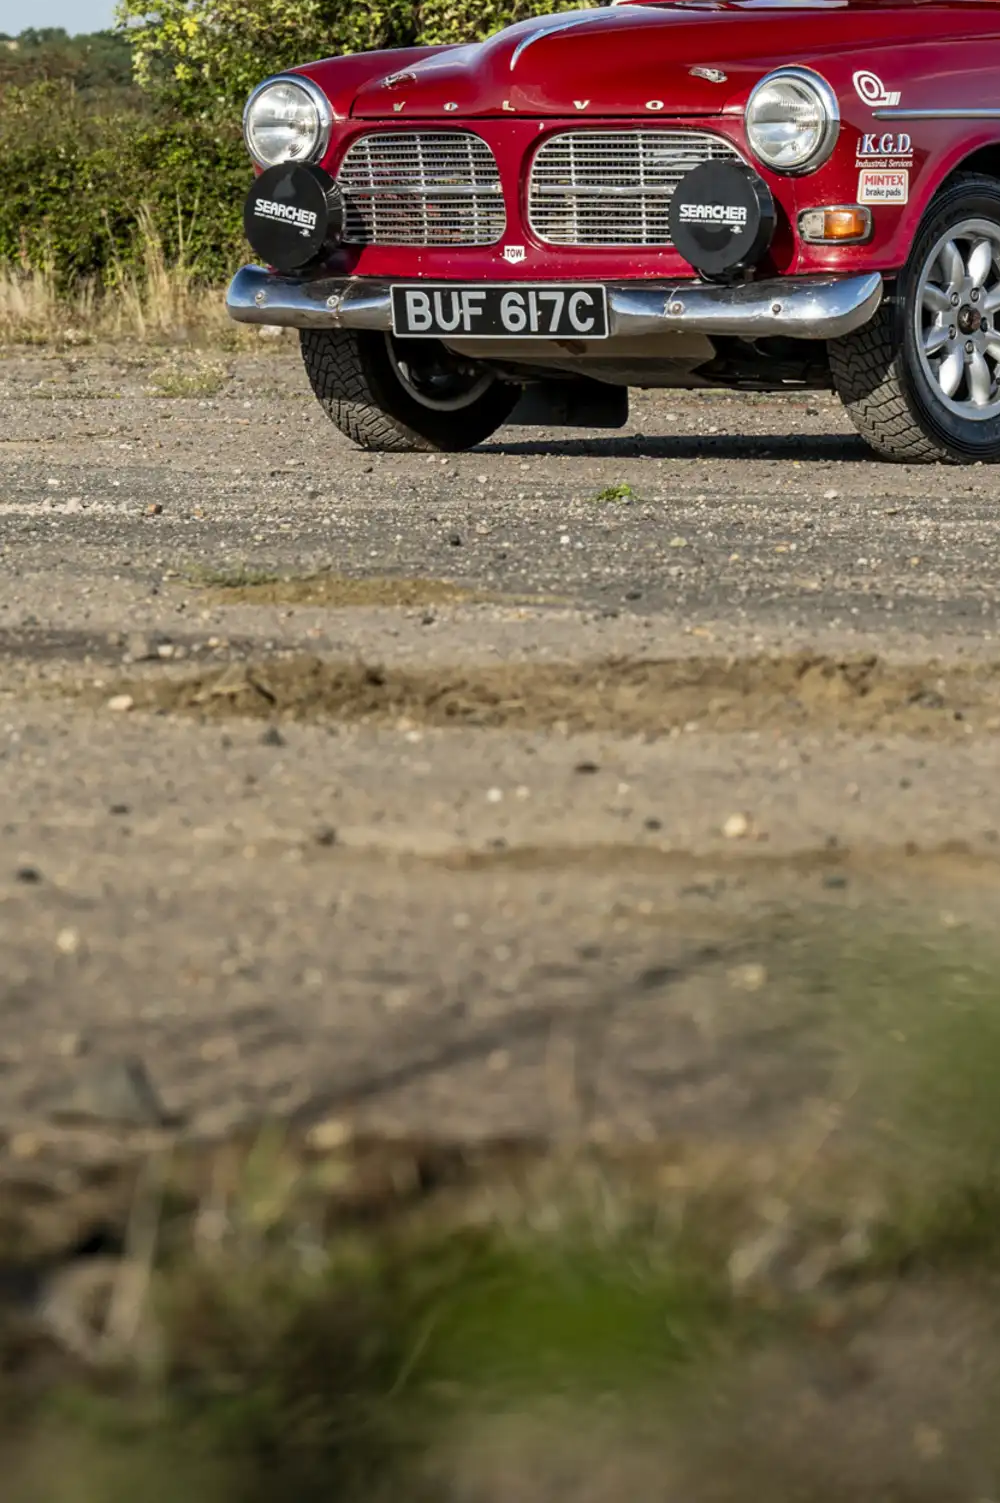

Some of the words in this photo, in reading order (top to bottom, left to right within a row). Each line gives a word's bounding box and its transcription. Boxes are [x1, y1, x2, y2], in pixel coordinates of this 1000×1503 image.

[393, 99, 664, 112] VOLVO
[861, 133, 914, 154] K.G.D.
[855, 159, 887, 168] Industrial
[888, 159, 913, 168] Services
[864, 175, 903, 186] MINTEX
[866, 188, 885, 196] brake
[886, 188, 901, 198] pads
[254, 198, 317, 226] SEARCHER
[680, 204, 747, 221] SEARCHER
[506, 248, 523, 258] TOW
[405, 291, 487, 332] BUF
[501, 291, 595, 333] 617C
